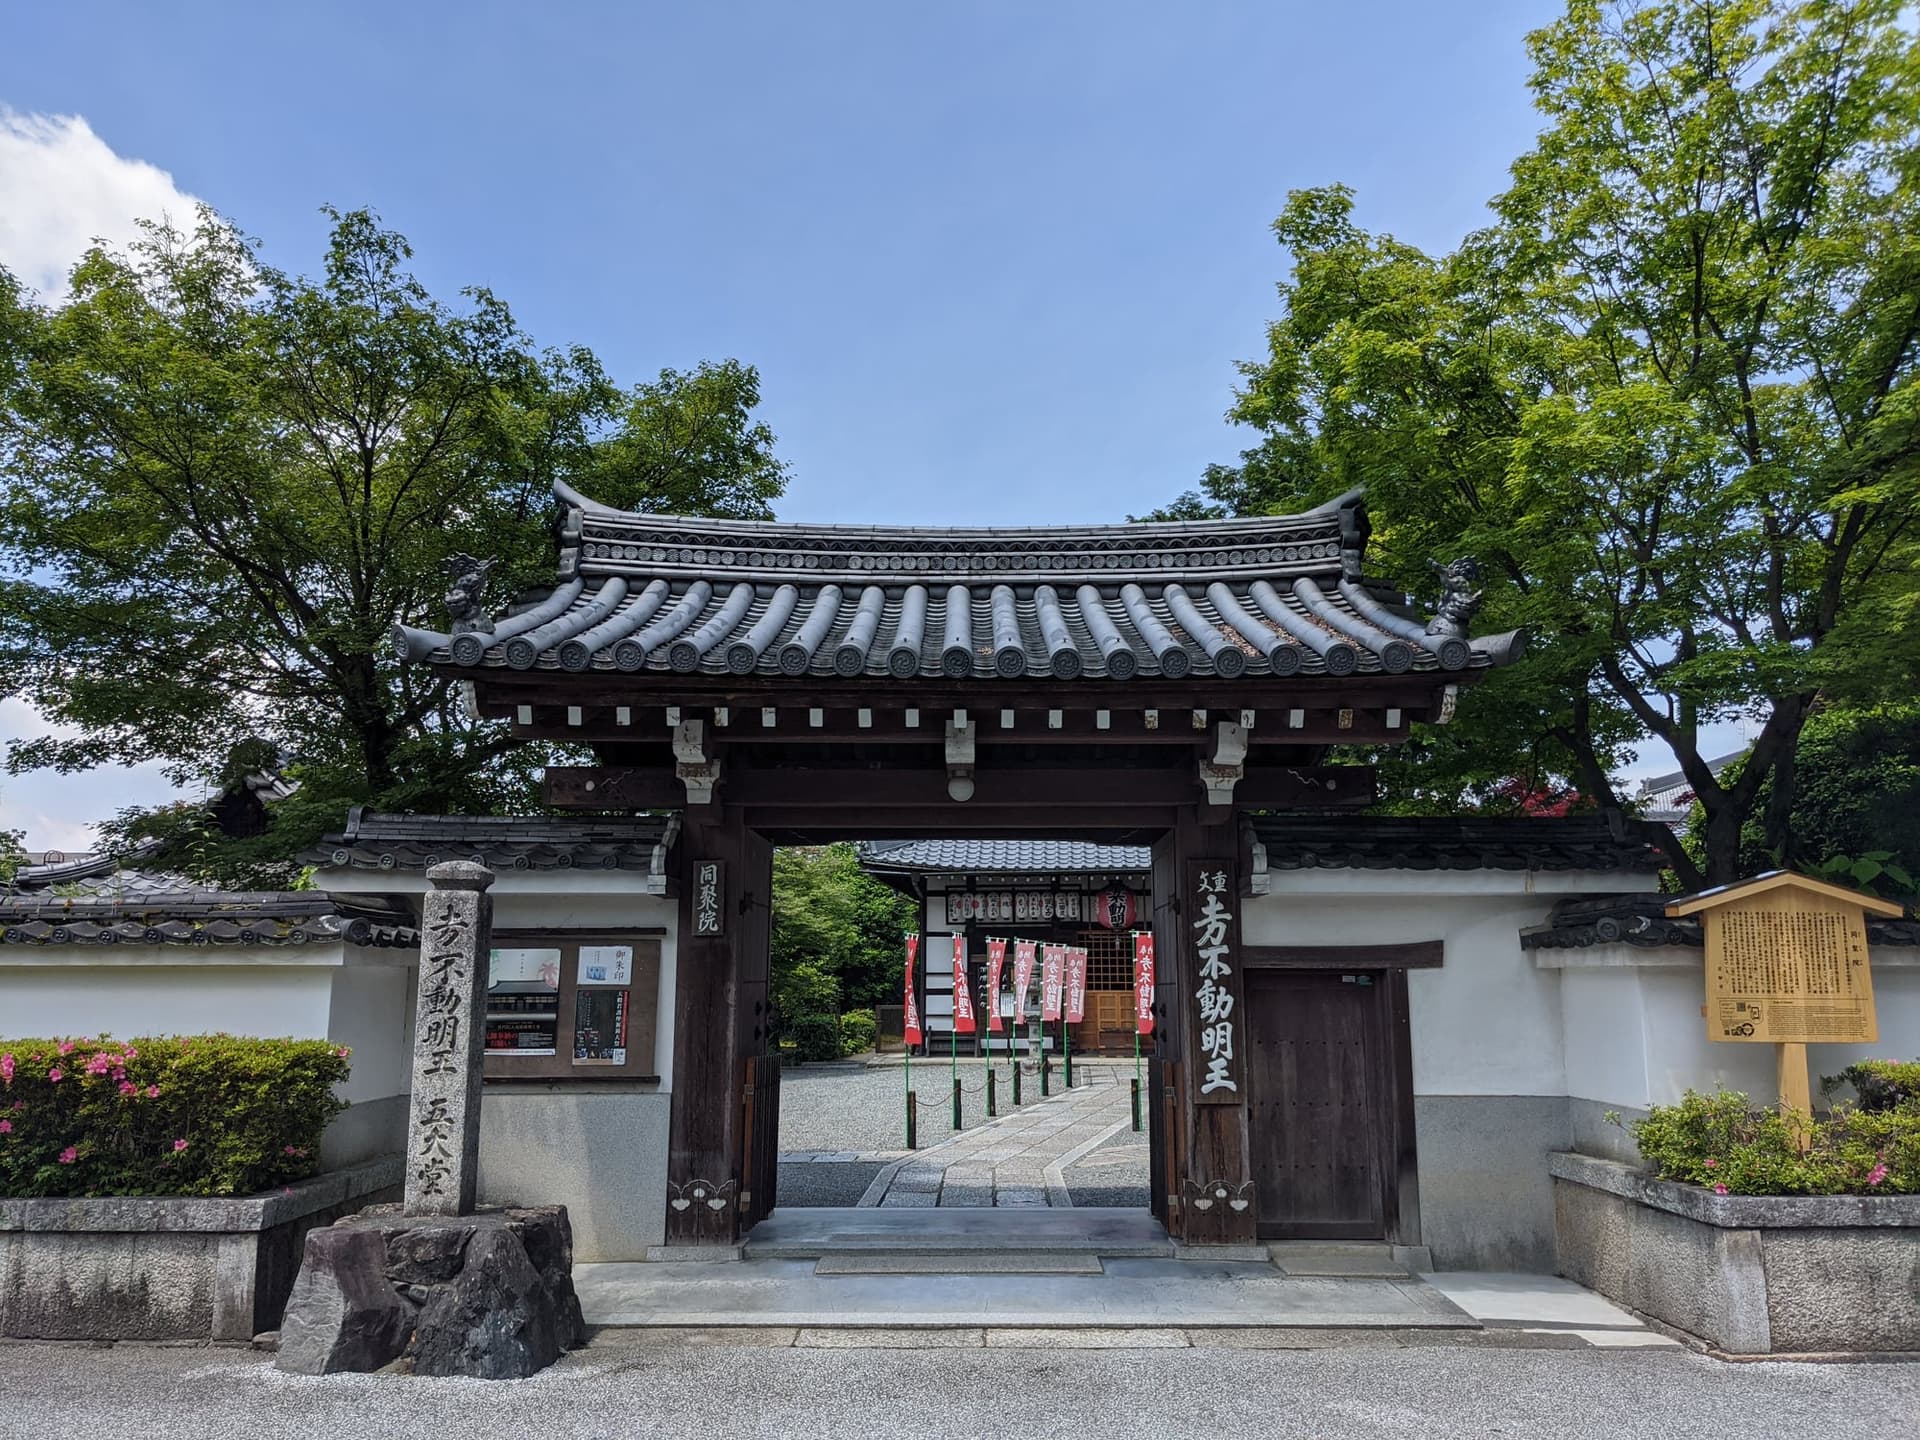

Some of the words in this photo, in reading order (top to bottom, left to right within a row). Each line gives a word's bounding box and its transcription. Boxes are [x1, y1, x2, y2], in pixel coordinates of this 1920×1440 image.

[697, 865, 718, 932] 同聚院
[613, 950, 626, 982] 御朱印
[418, 1098, 455, 1195] 五大堂
